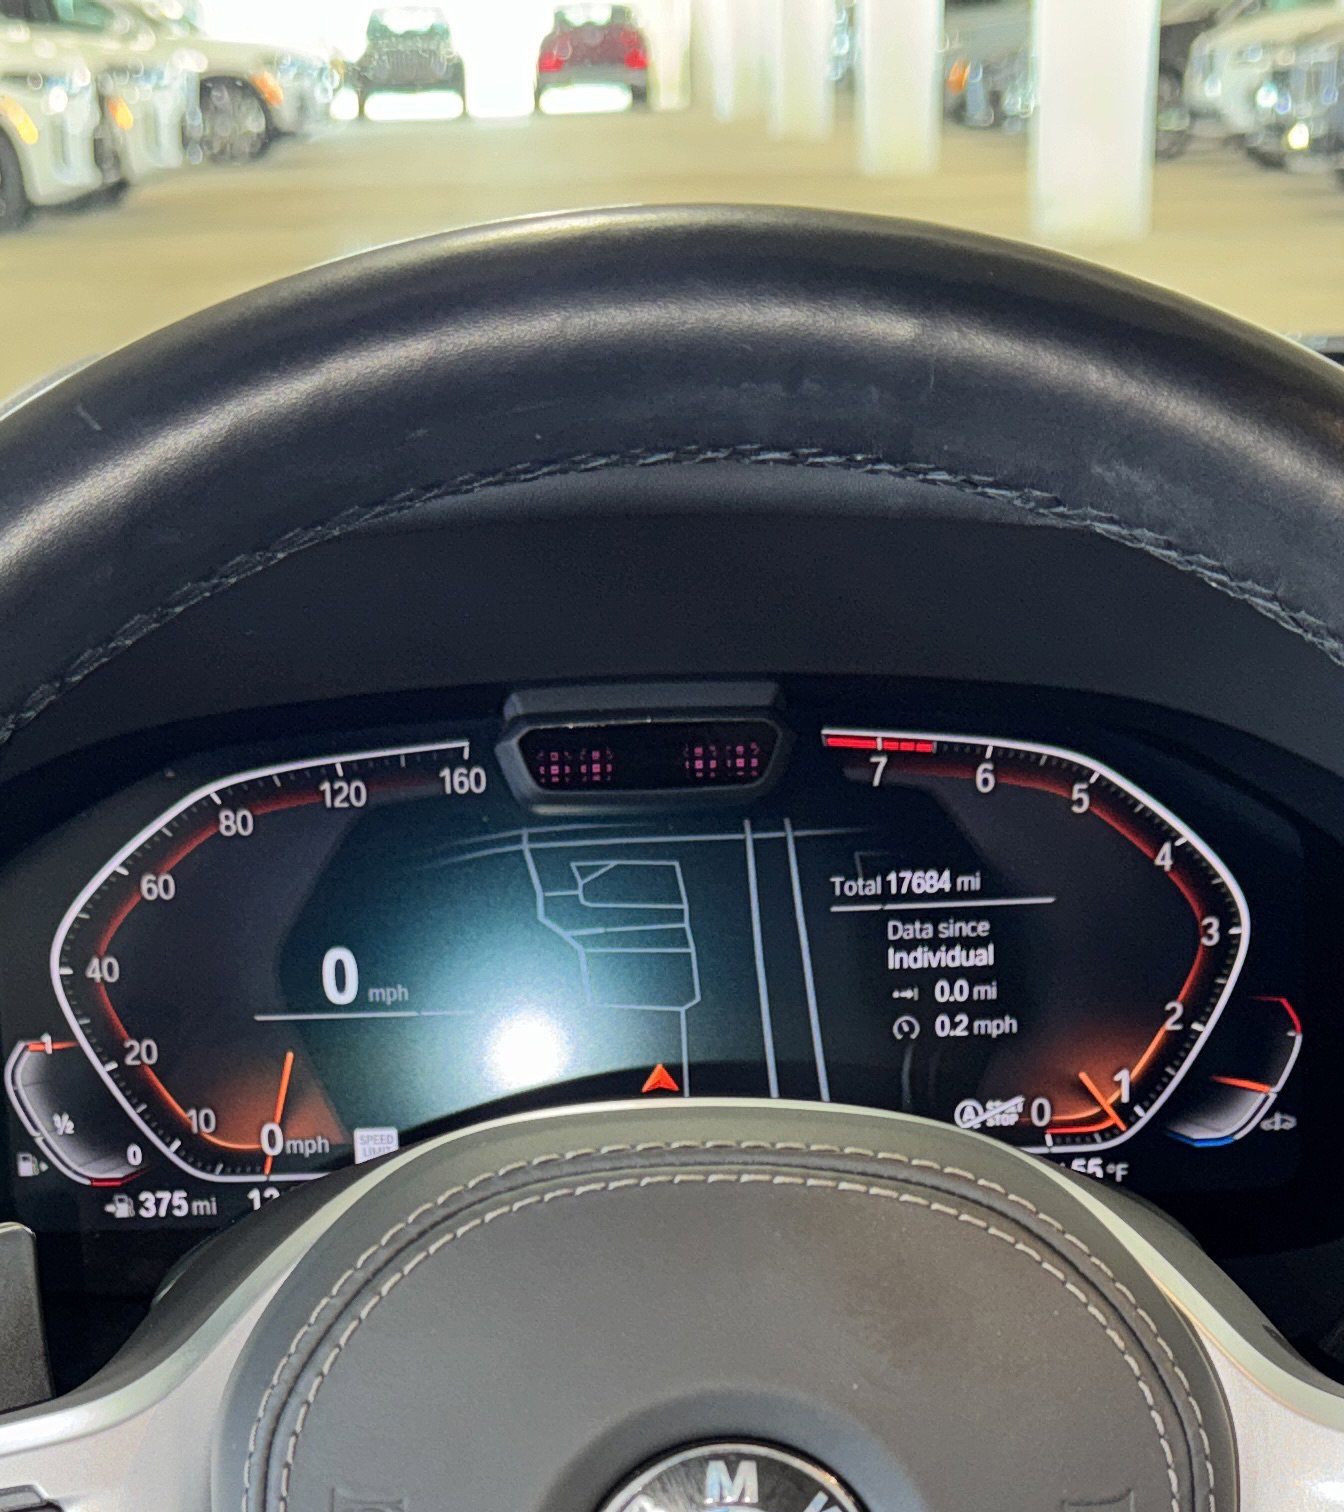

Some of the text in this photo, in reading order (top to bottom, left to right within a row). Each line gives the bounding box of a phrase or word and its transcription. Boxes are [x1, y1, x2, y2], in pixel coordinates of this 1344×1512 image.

[439, 767, 487, 795] 160
[868, 757, 888, 788] 7
[975, 764, 996, 793] 6
[319, 781, 367, 809] 120
[1071, 784, 1091, 814] 5
[218, 810, 254, 837] 80
[1154, 844, 1174, 871] 4
[140, 873, 176, 900] 60
[831, 870, 981, 897] Total 17684 mi
[887, 917, 990, 940] Data since
[1200, 917, 1220, 945] 3
[887, 943, 994, 969] Individual
[85, 957, 120, 984] 40
[321, 947, 409, 1004] 0 mph
[935, 980, 997, 1003] 0.0 mi
[935, 1014, 1017, 1038] 0.2 mph
[1164, 1003, 1184, 1029] 2
[123, 1039, 158, 1066] 20
[1113, 1068, 1131, 1103] 1
[186, 1108, 216, 1134] 10
[1030, 1097, 1051, 1127] 0
[260, 1122, 330, 1156] 0 mph
[359, 1134, 394, 1146] SPEED
[126, 1144, 143, 1166] 0
[138, 1190, 217, 1217] 375 mi
